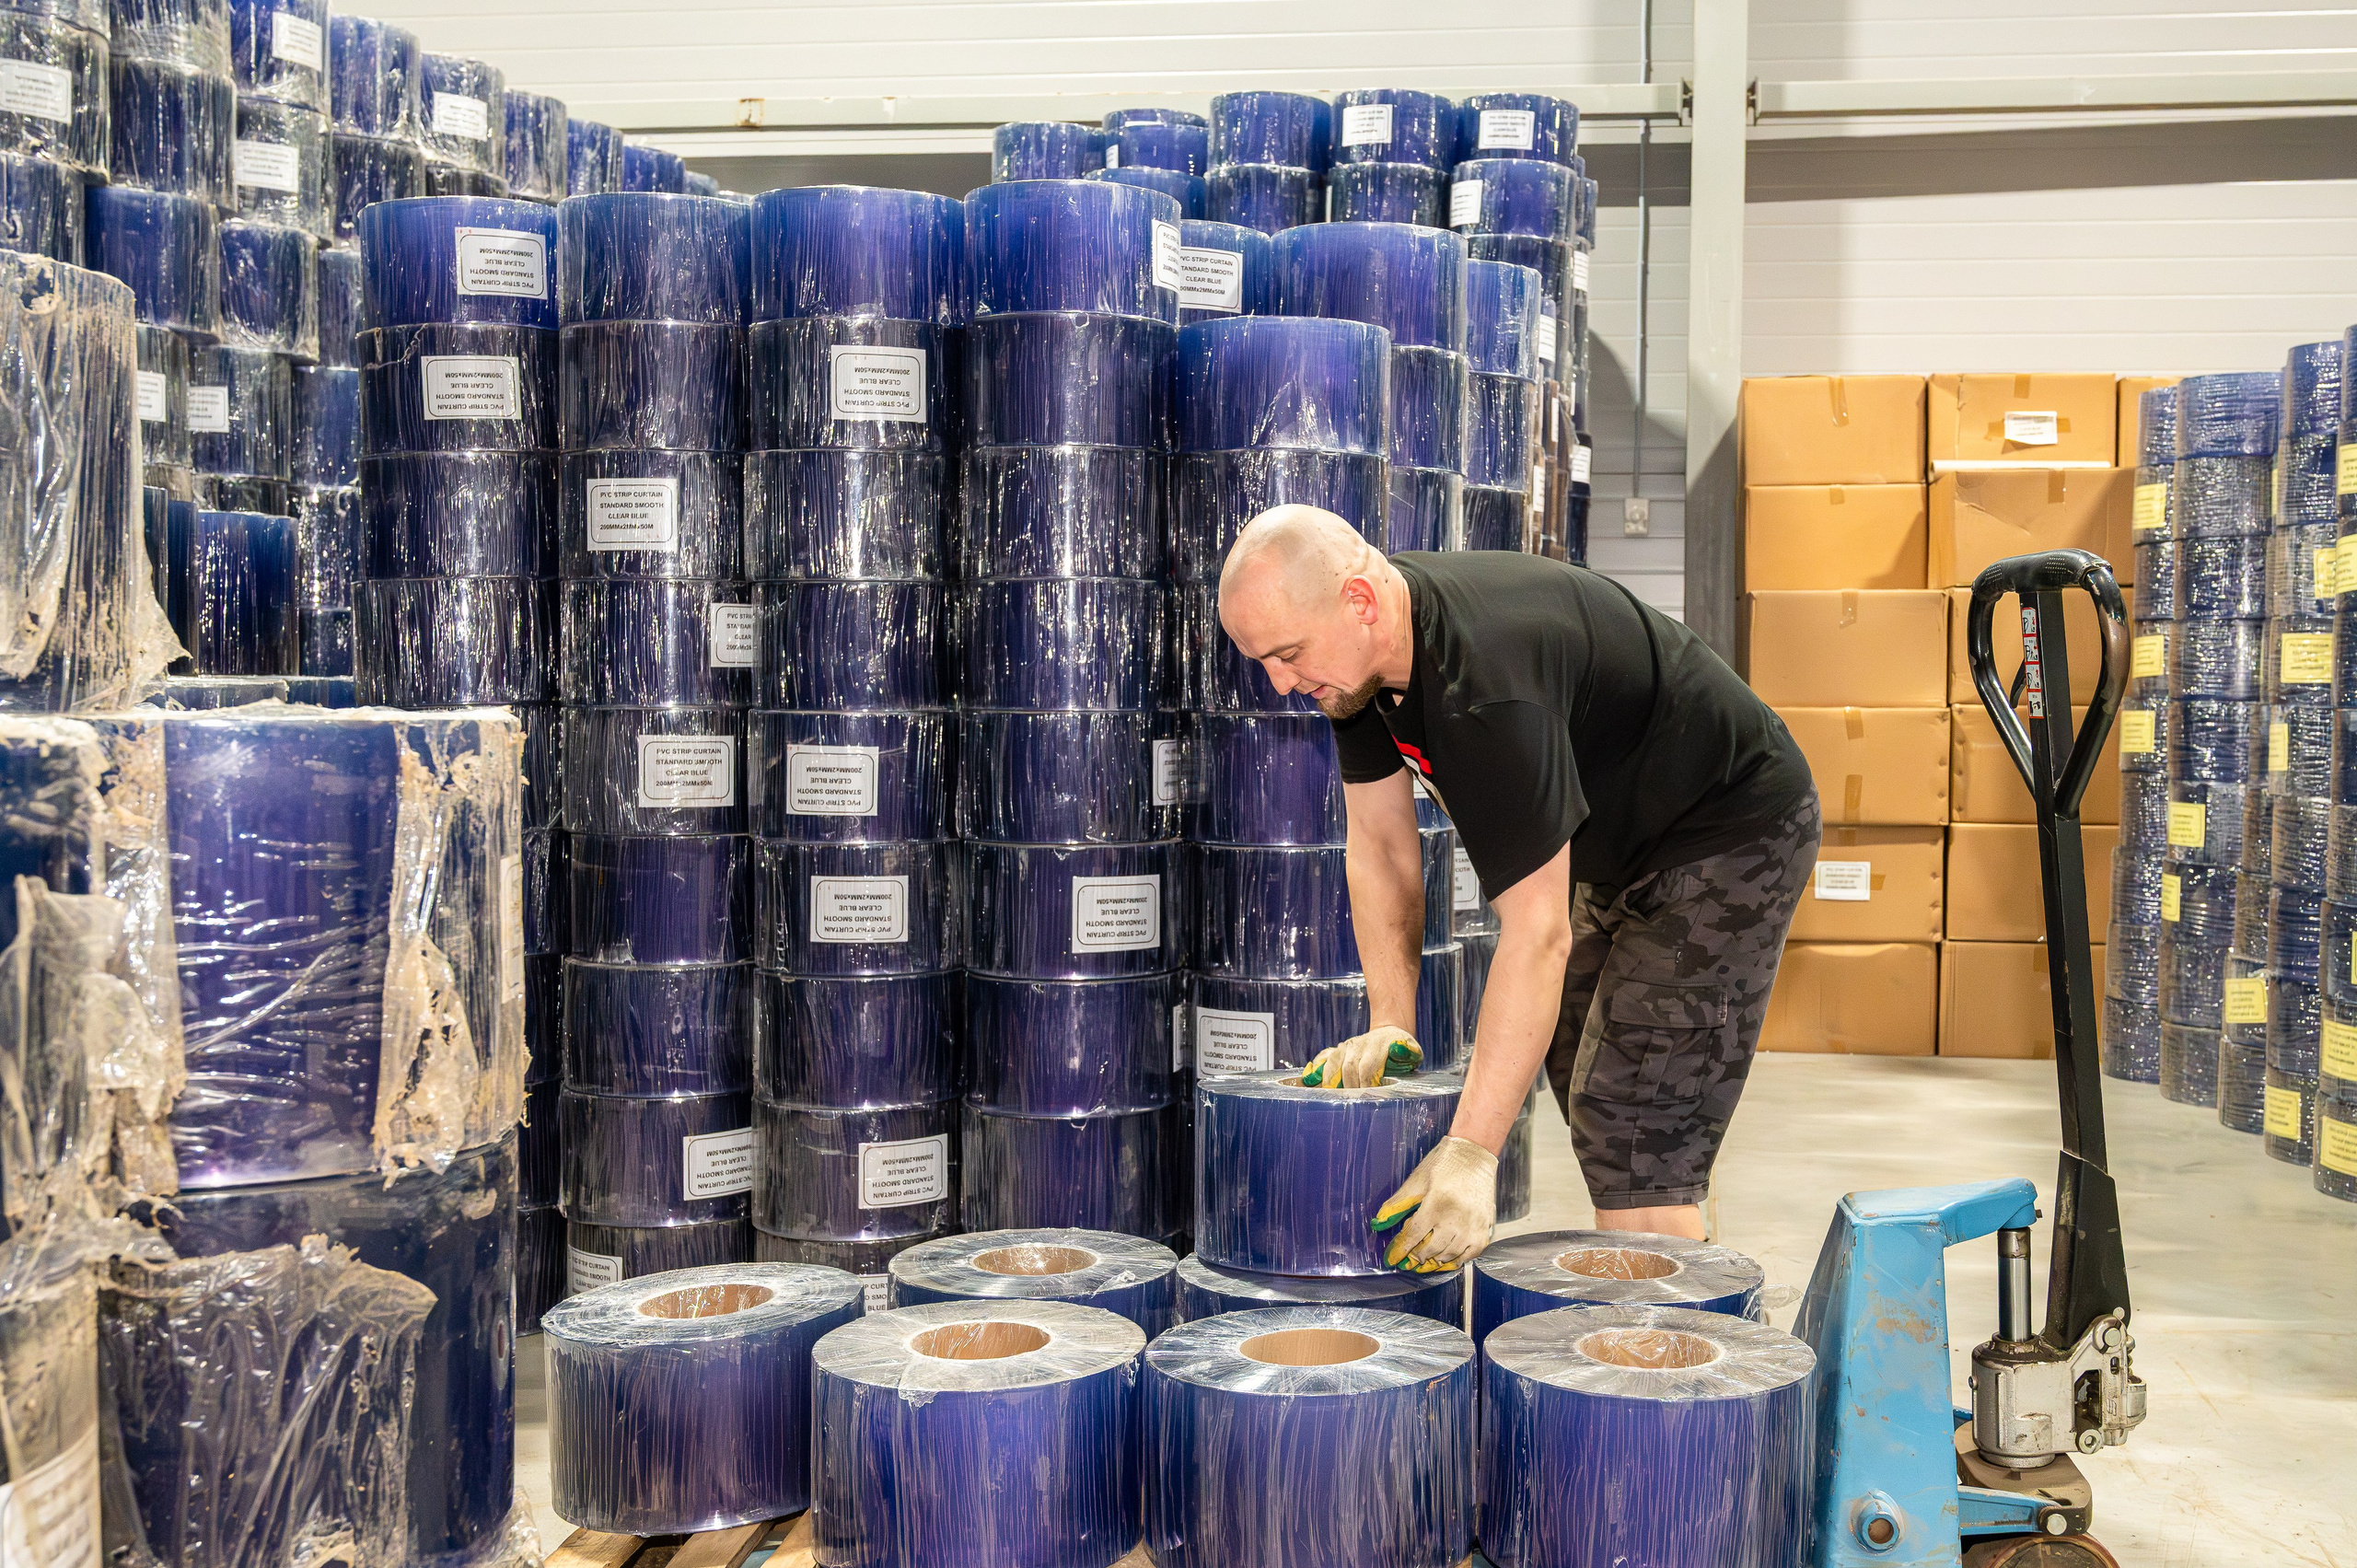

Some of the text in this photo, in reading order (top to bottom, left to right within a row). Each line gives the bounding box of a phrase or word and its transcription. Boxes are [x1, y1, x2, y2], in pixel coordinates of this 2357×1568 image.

[500, 270, 534, 278] STANDARD
[872, 1175, 934, 1188] STANDARD SMOOTH
